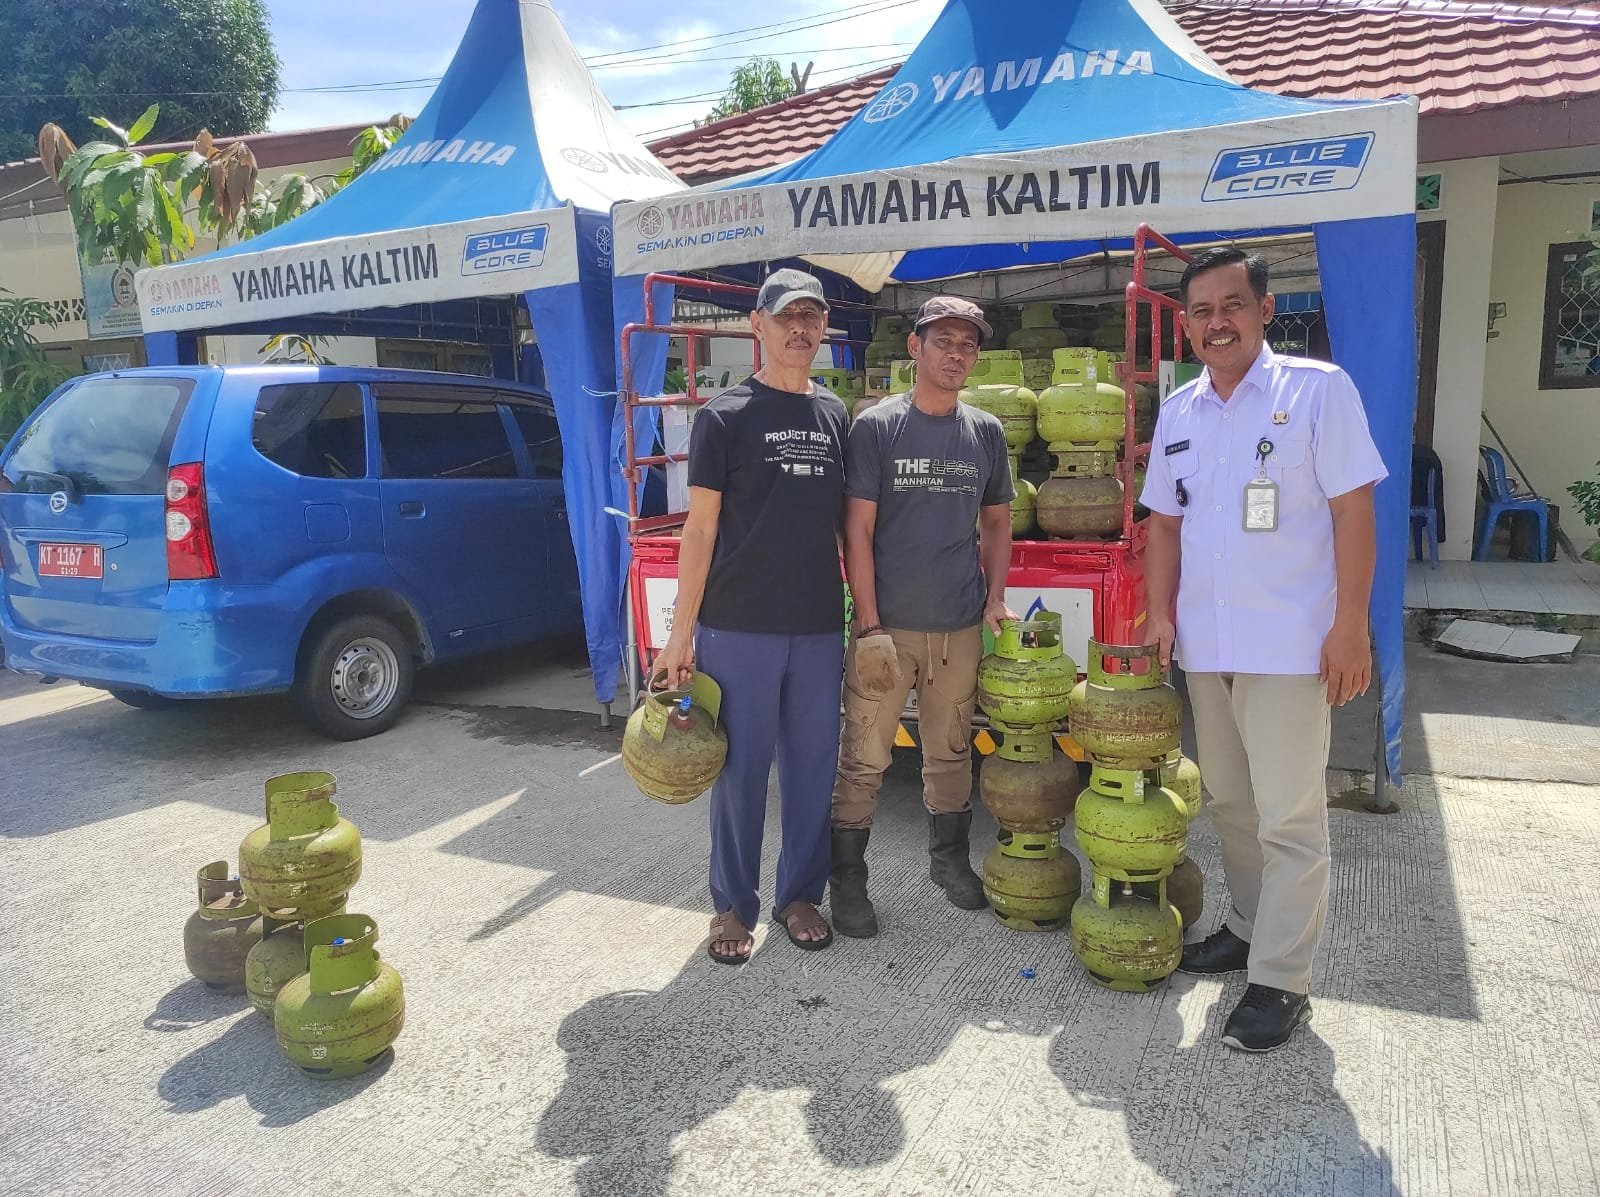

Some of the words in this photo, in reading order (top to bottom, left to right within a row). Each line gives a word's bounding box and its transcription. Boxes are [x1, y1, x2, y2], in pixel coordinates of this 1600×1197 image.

[932, 49, 1155, 104] YAMAHA
[1236, 143, 1347, 169] BLUE
[1227, 169, 1336, 193] CORE
[786, 178, 971, 228] YAMAHA
[987, 161, 1160, 216] KALTIM
[667, 192, 765, 231] YAMAHA
[476, 231, 535, 251] BLUE
[716, 224, 765, 242] DEPAN
[473, 251, 531, 270] CORE
[232, 258, 336, 303] YAMAHA
[341, 243, 439, 289] KALTIM
[165, 275, 221, 300] YAMAHA
[195, 299, 223, 311] DEPAN
[765, 429, 807, 443] PROJECT
[810, 431, 832, 445] ROCK
[894, 458, 930, 474] THE
[894, 477, 944, 486] MANHATAN
[40, 546, 52, 565] KT
[56, 546, 82, 566] 1167
[93, 547, 100, 566] H
